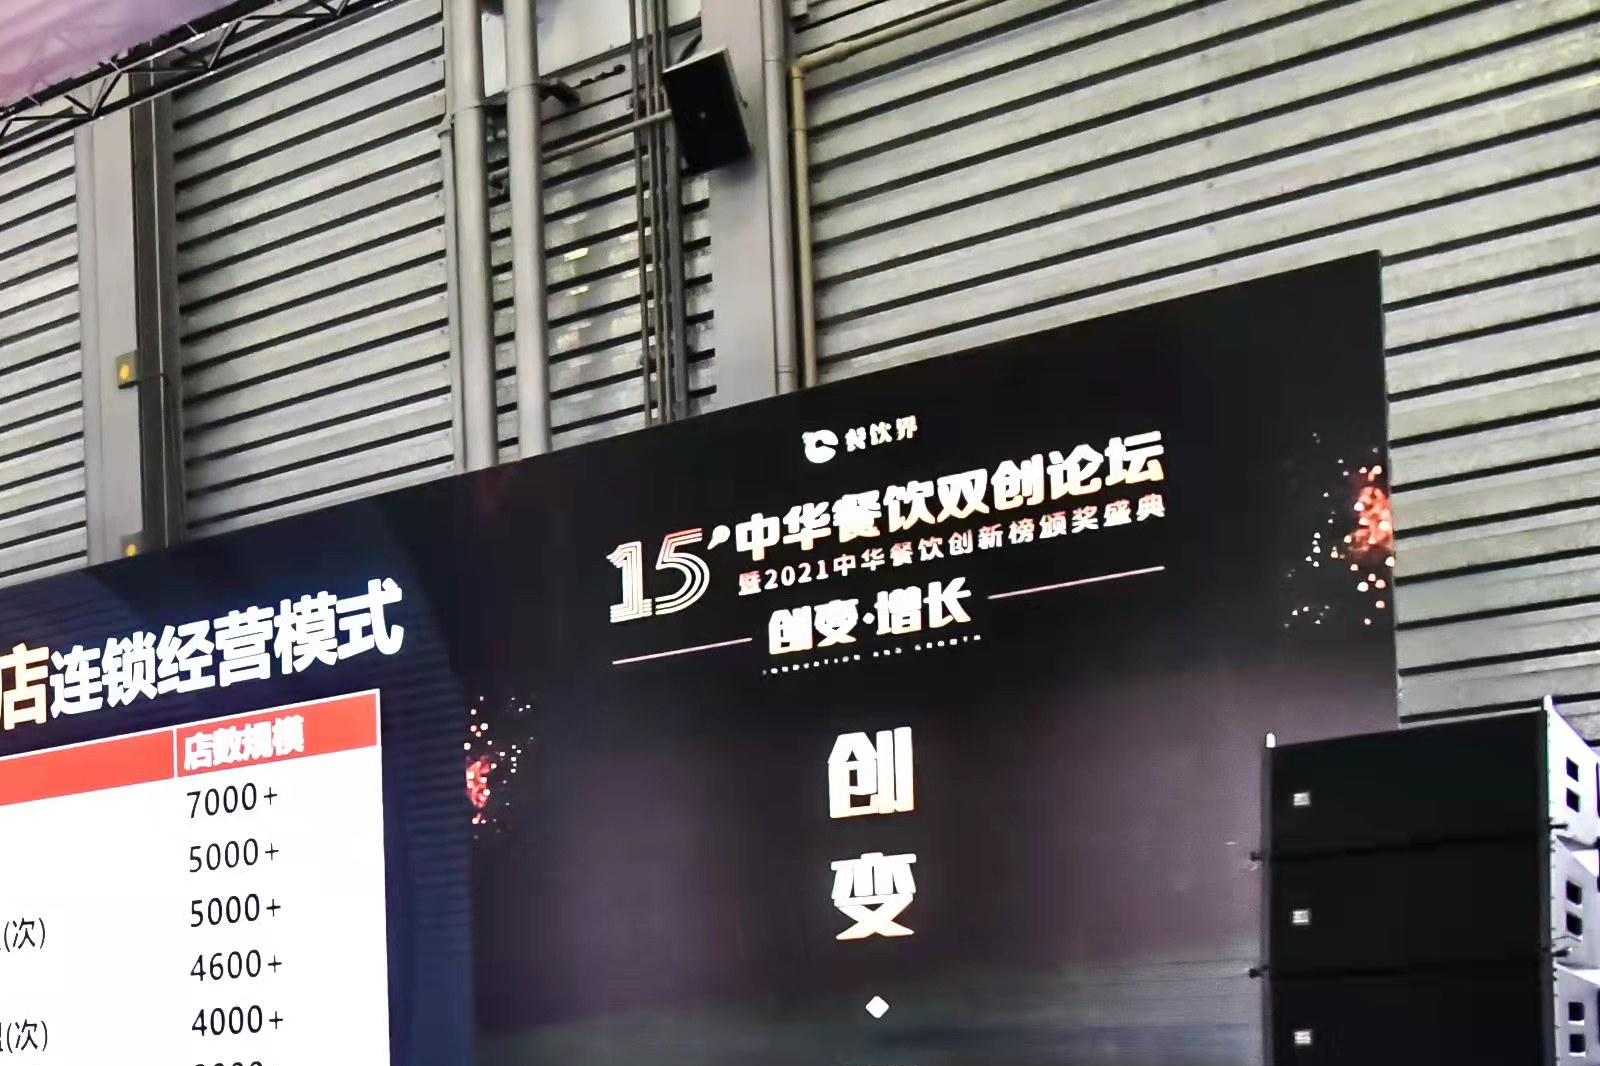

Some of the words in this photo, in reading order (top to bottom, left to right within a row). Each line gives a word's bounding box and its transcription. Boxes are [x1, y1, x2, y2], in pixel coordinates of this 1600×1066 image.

[735, 430, 1165, 562] 中华餐饮双创论坛
[184, 715, 305, 770] 店数规模
[187, 782, 278, 818] 7000+
[189, 838, 280, 873] 5000+
[190, 893, 281, 928] 5000+
[190, 949, 283, 982] 4600+
[191, 1004, 284, 1036] 4000+
